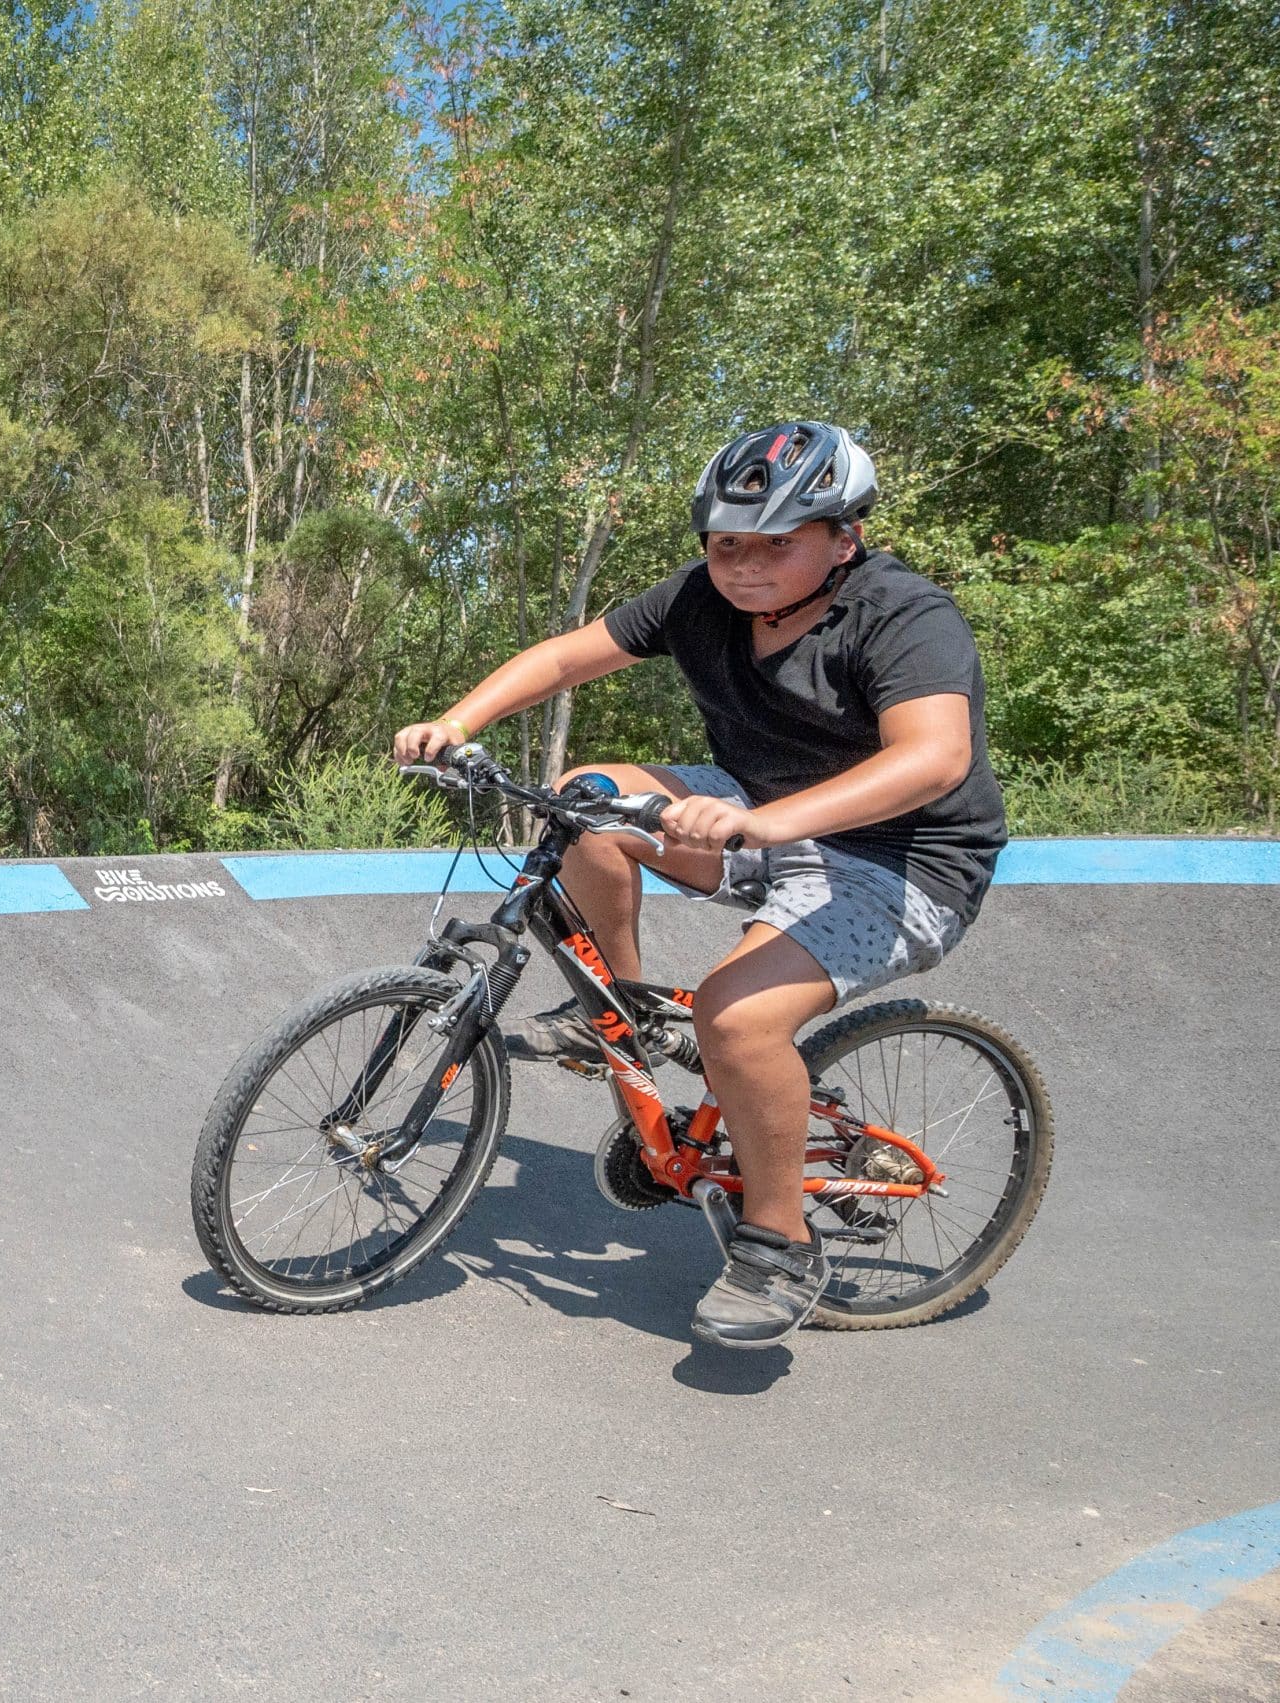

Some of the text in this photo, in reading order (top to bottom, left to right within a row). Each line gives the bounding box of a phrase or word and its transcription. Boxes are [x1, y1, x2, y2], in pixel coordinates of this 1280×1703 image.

[95, 869, 147, 886] BIKE
[94, 881, 226, 902] SOLUTIONS
[672, 987, 694, 1008] 24
[614, 1069, 663, 1104] TWENTY
